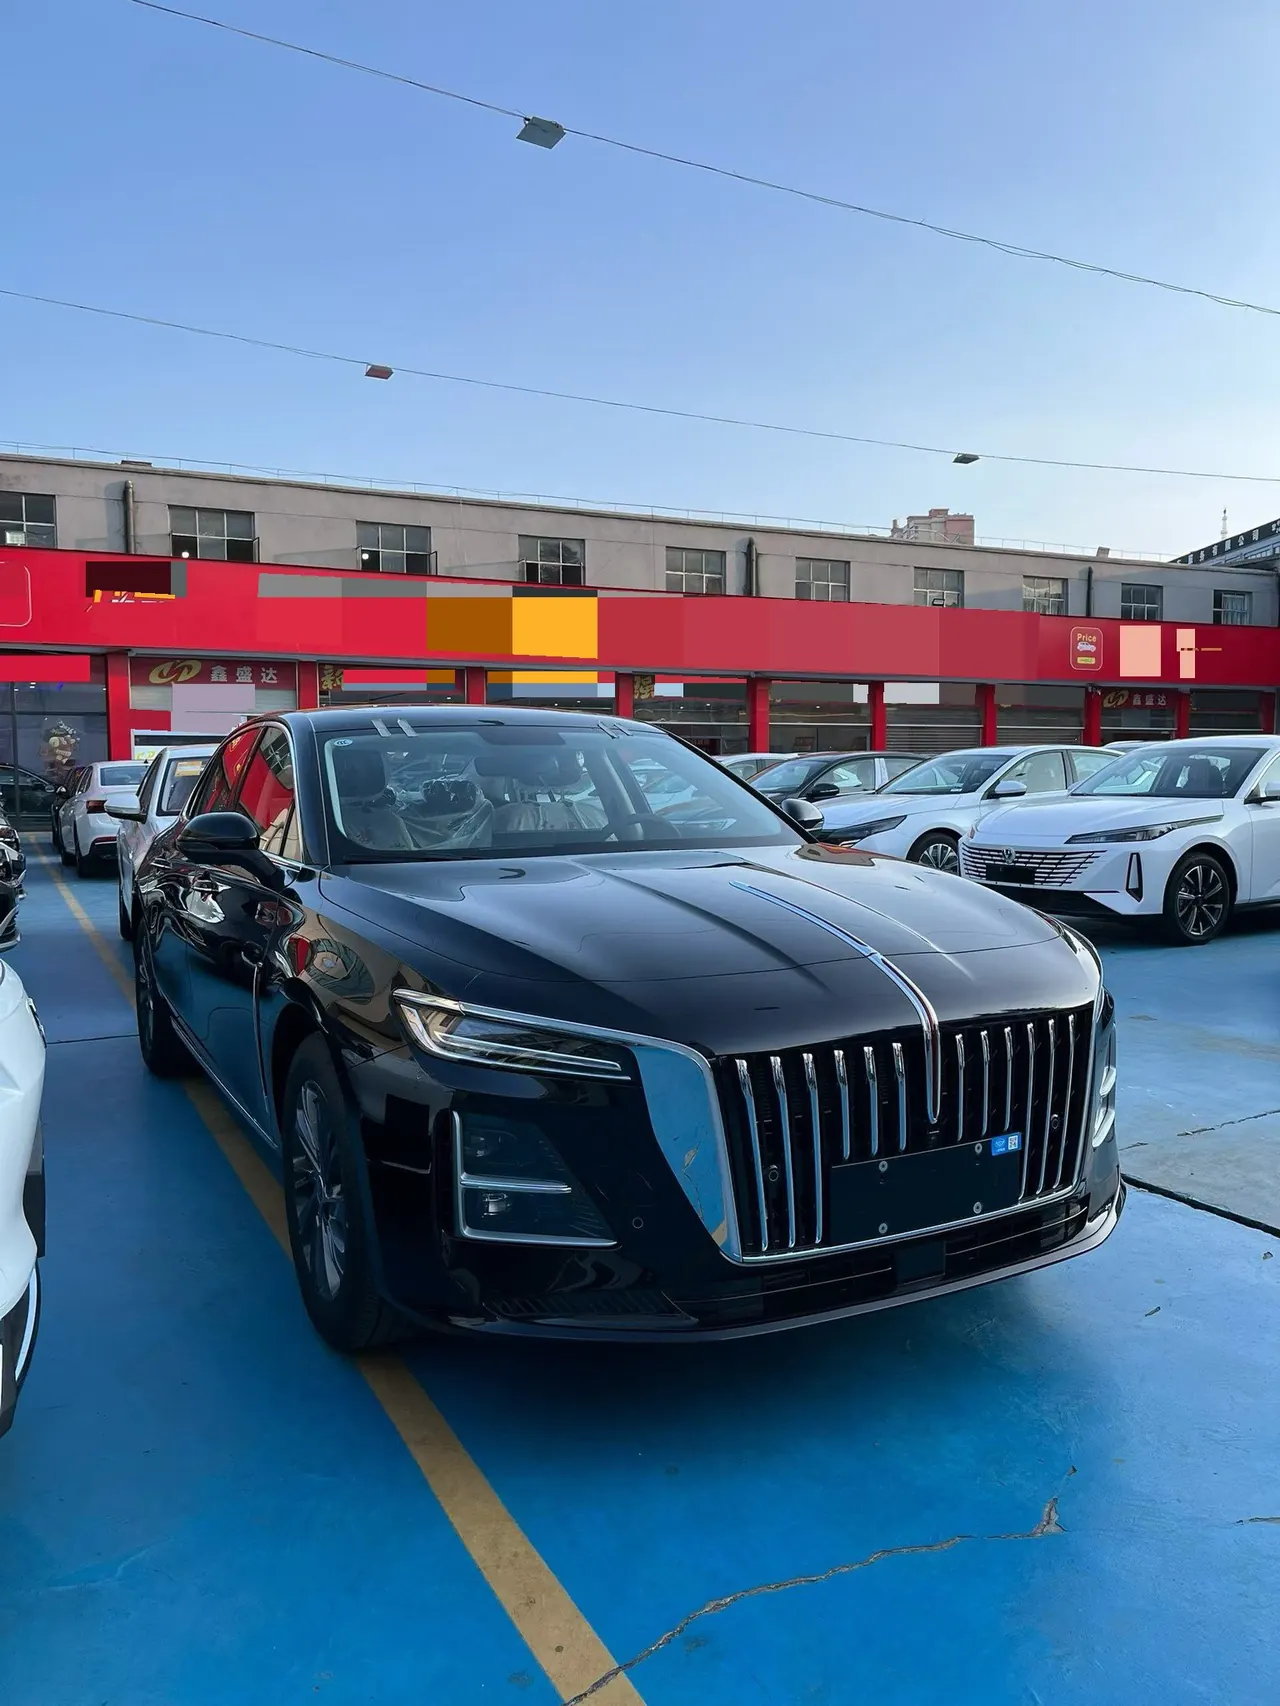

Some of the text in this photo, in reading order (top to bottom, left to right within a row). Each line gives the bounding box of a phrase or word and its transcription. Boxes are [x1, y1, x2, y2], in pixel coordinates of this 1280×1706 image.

[1077, 633, 1097, 642] Price
[210, 665, 278, 684] 鑫盛达
